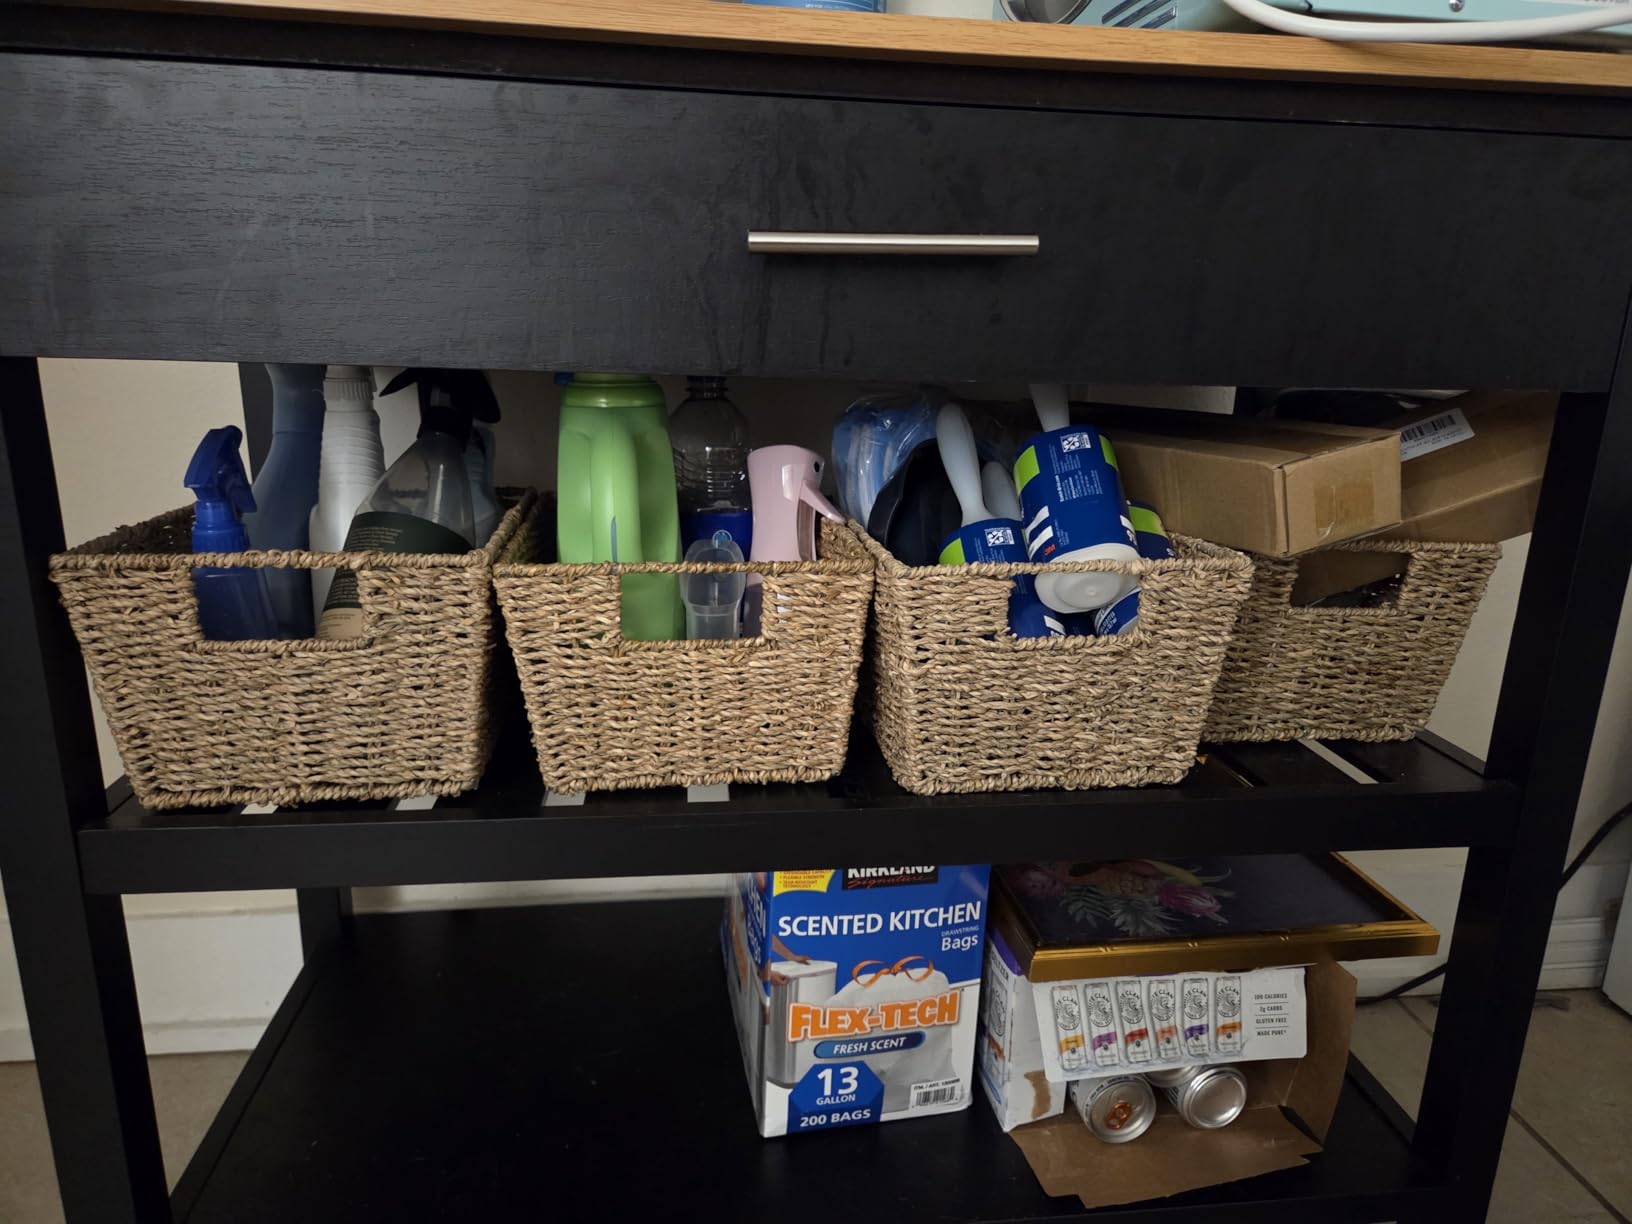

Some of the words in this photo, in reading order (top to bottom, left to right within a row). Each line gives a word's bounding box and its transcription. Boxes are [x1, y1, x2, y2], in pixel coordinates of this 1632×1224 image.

[778, 913, 883, 937] SCENTED
[889, 901, 981, 932] KITCHEN
[941, 925, 979, 937] DRAWSTRING
[941, 935, 979, 952] Bags
[789, 990, 961, 1041] FLEX-TECH
[833, 1042, 868, 1054] FRESH
[870, 1037, 906, 1050] SCENT
[817, 1066, 859, 1096] 13
[816, 1094, 856, 1106] GALLON
[800, 1115, 826, 1127] 200
[831, 1109, 871, 1123] BAGS
